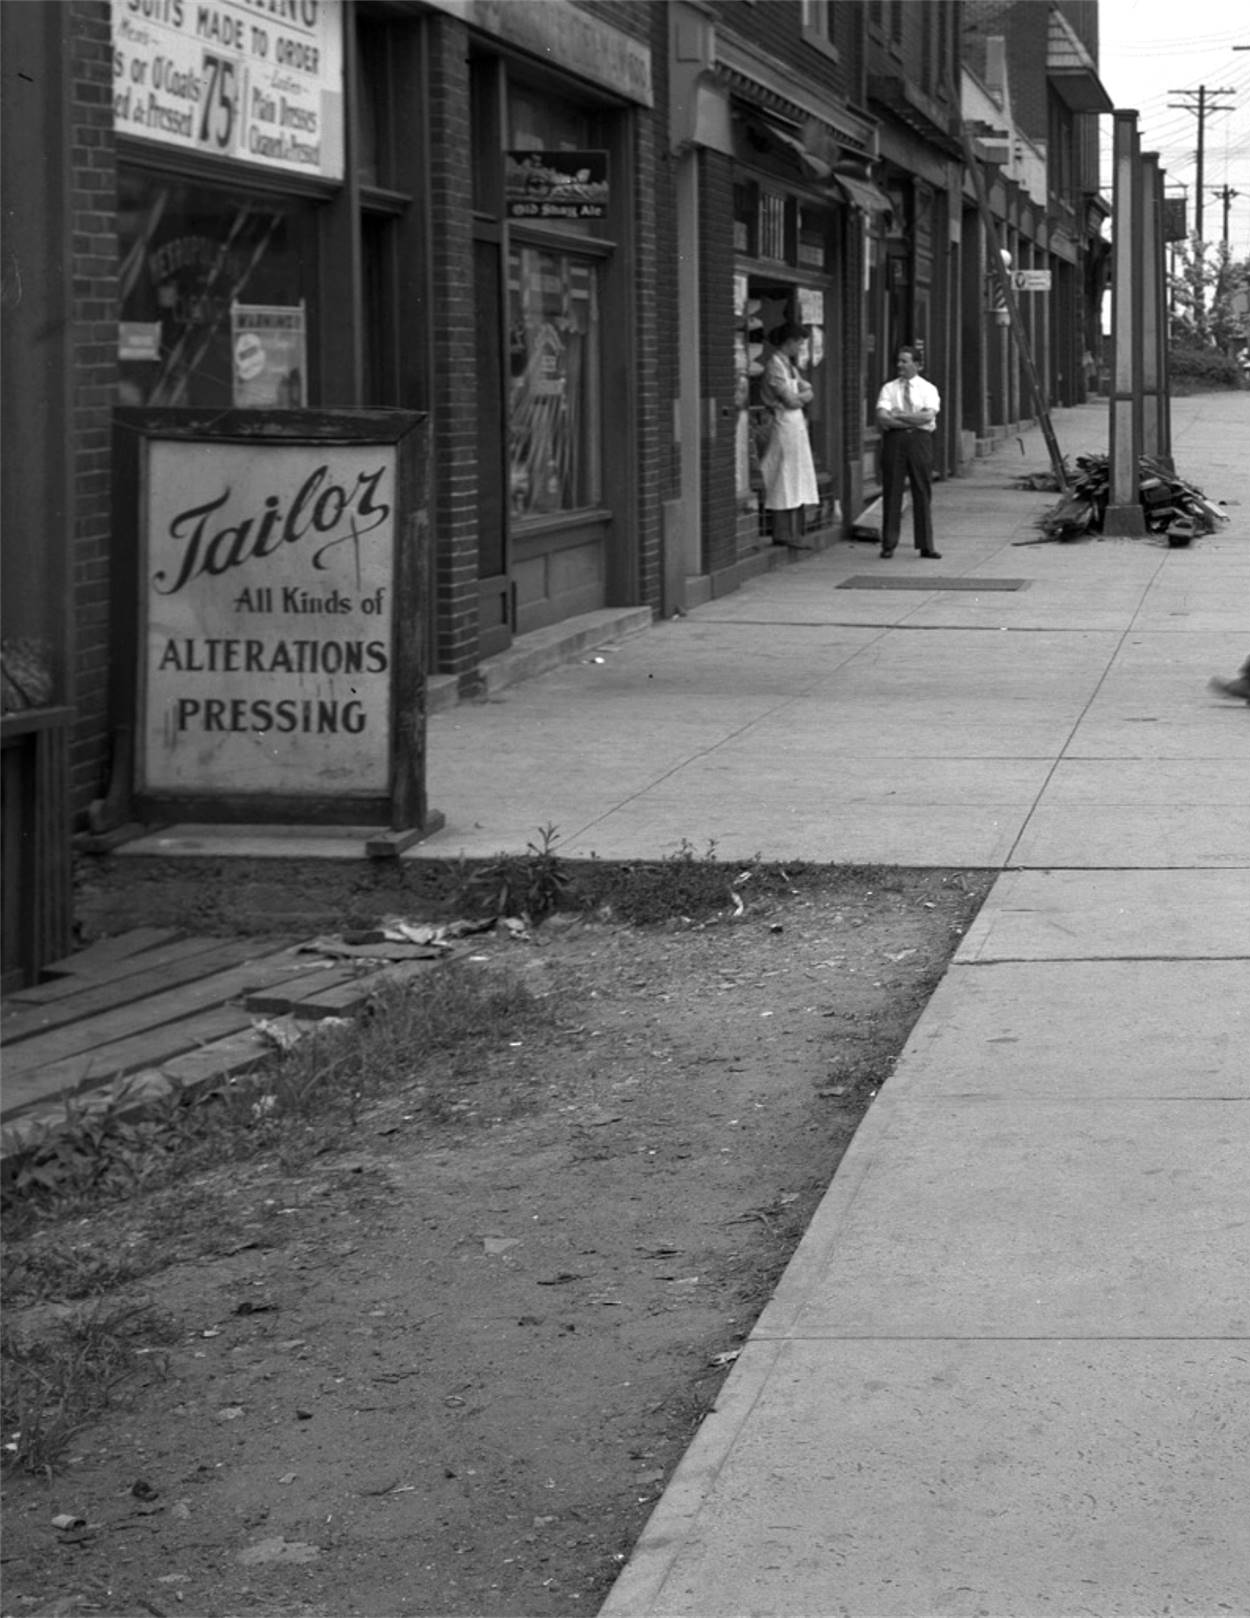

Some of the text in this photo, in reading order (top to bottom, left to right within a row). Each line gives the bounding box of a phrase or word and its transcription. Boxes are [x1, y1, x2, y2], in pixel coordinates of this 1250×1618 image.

[194, 6, 242, 50] MADE
[248, 24, 267, 57] TO
[274, 36, 319, 75] ORDER
[130, 58, 148, 85] or
[147, 92, 193, 138] Pressed
[280, 96, 318, 133] Dresses
[512, 203, 538, 216] Old
[580, 204, 602, 216] Ale
[153, 465, 390, 595] Tailor
[234, 587, 387, 615] All Kinds of
[158, 637, 388, 675] ALTERATIONS
[177, 698, 367, 734] PRESSING
